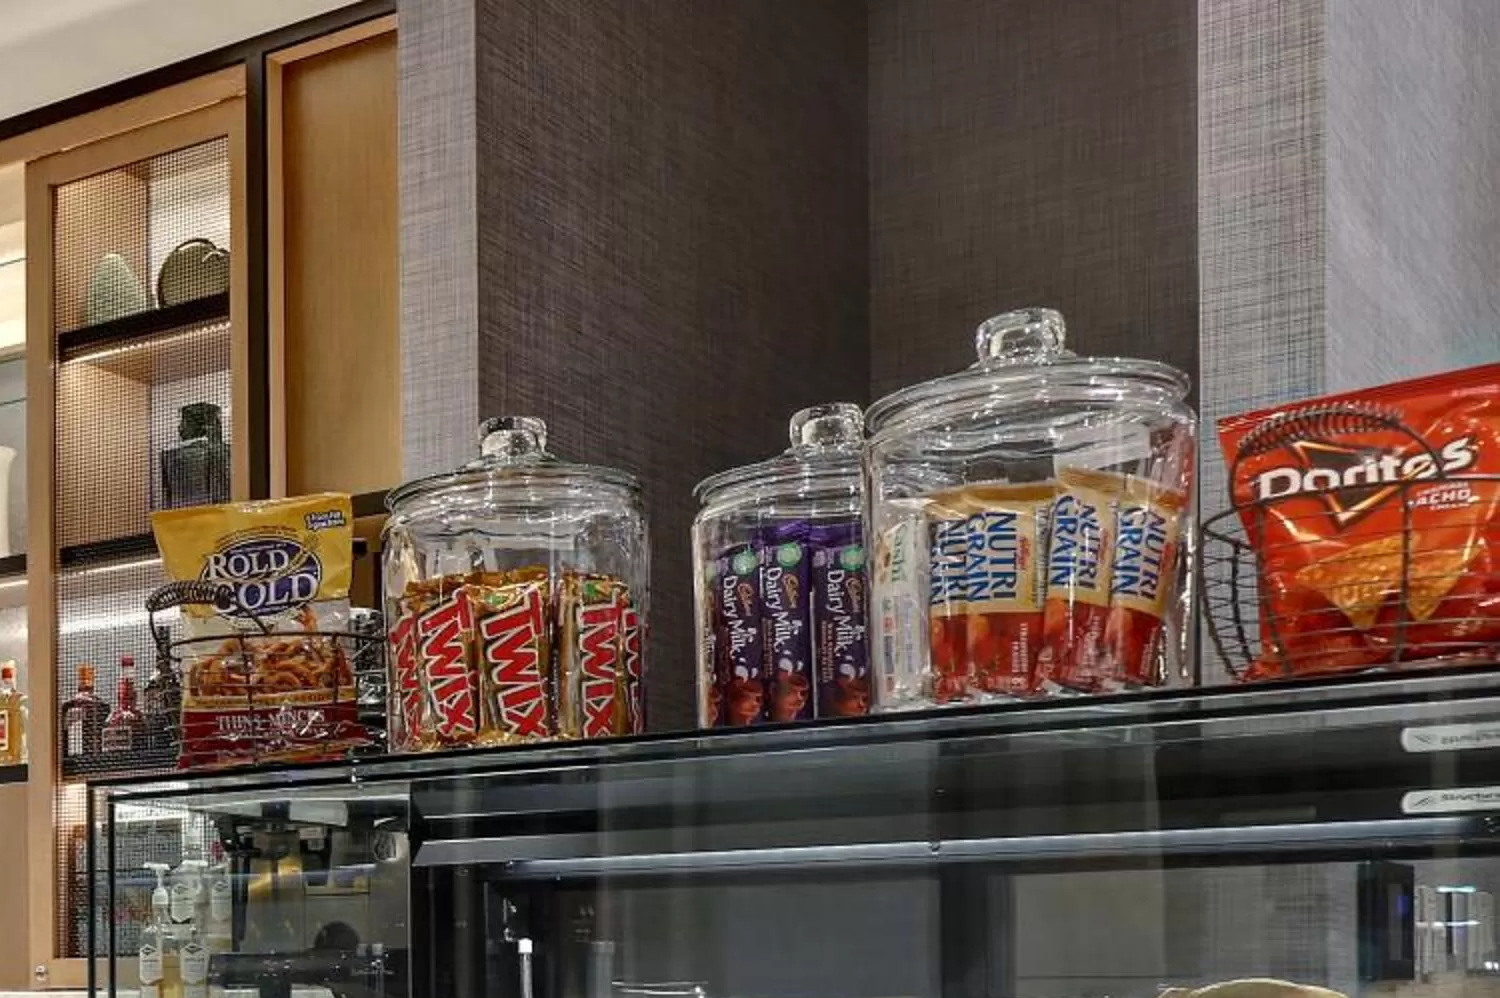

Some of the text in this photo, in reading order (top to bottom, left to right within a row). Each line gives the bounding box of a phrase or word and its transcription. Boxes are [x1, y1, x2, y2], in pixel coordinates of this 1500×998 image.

[1250, 437, 1477, 500] Doritos
[1408, 488, 1472, 507] ACHO
[206, 549, 289, 581] ROLD
[964, 511, 993, 602] GRAIN
[984, 511, 1017, 599] NUTRI
[1050, 494, 1080, 586] GRAIN
[1076, 504, 1100, 590] NUTRI
[1112, 507, 1148, 596] GRAIN
[1140, 509, 1168, 601] NUTRI
[722, 574, 748, 660] Dairy Milk
[764, 566, 792, 653] Dairy Milk
[825, 569, 846, 614] Dairy
[831, 613, 854, 657] Milk
[417, 586, 476, 736] TWIX
[479, 586, 549, 737] TWIX
[575, 589, 627, 737] TWIX
